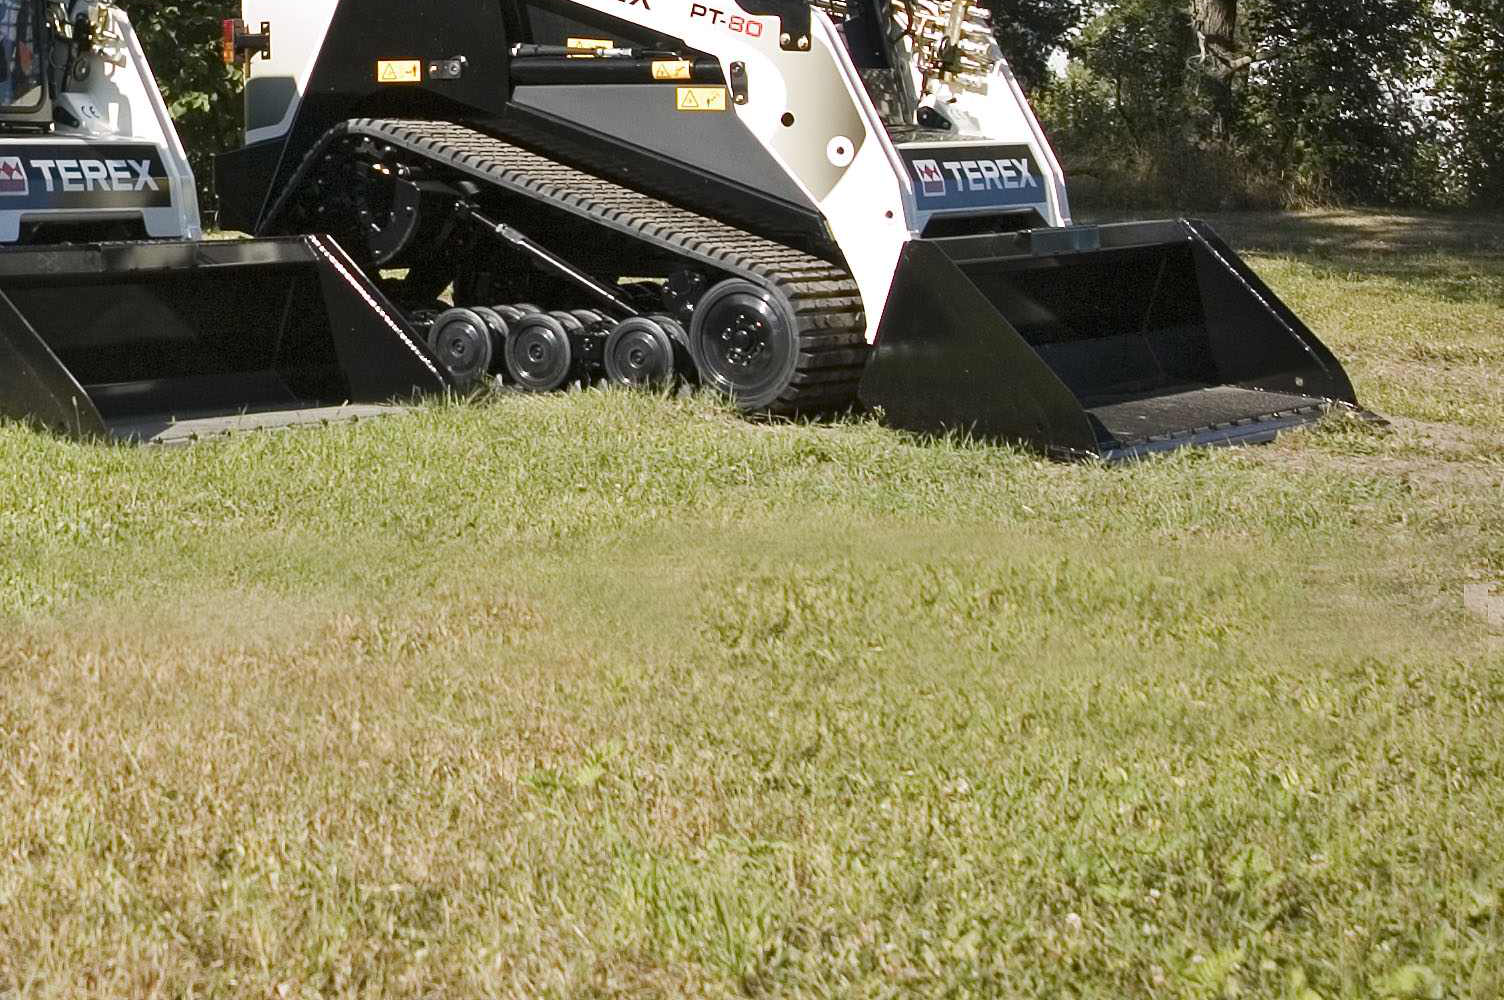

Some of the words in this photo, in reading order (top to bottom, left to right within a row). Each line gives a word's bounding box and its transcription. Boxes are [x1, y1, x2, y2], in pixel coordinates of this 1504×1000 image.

[690, 3, 763, 37] PT-80
[30, 159, 159, 192] TEREX
[943, 158, 1037, 192] TEREX
